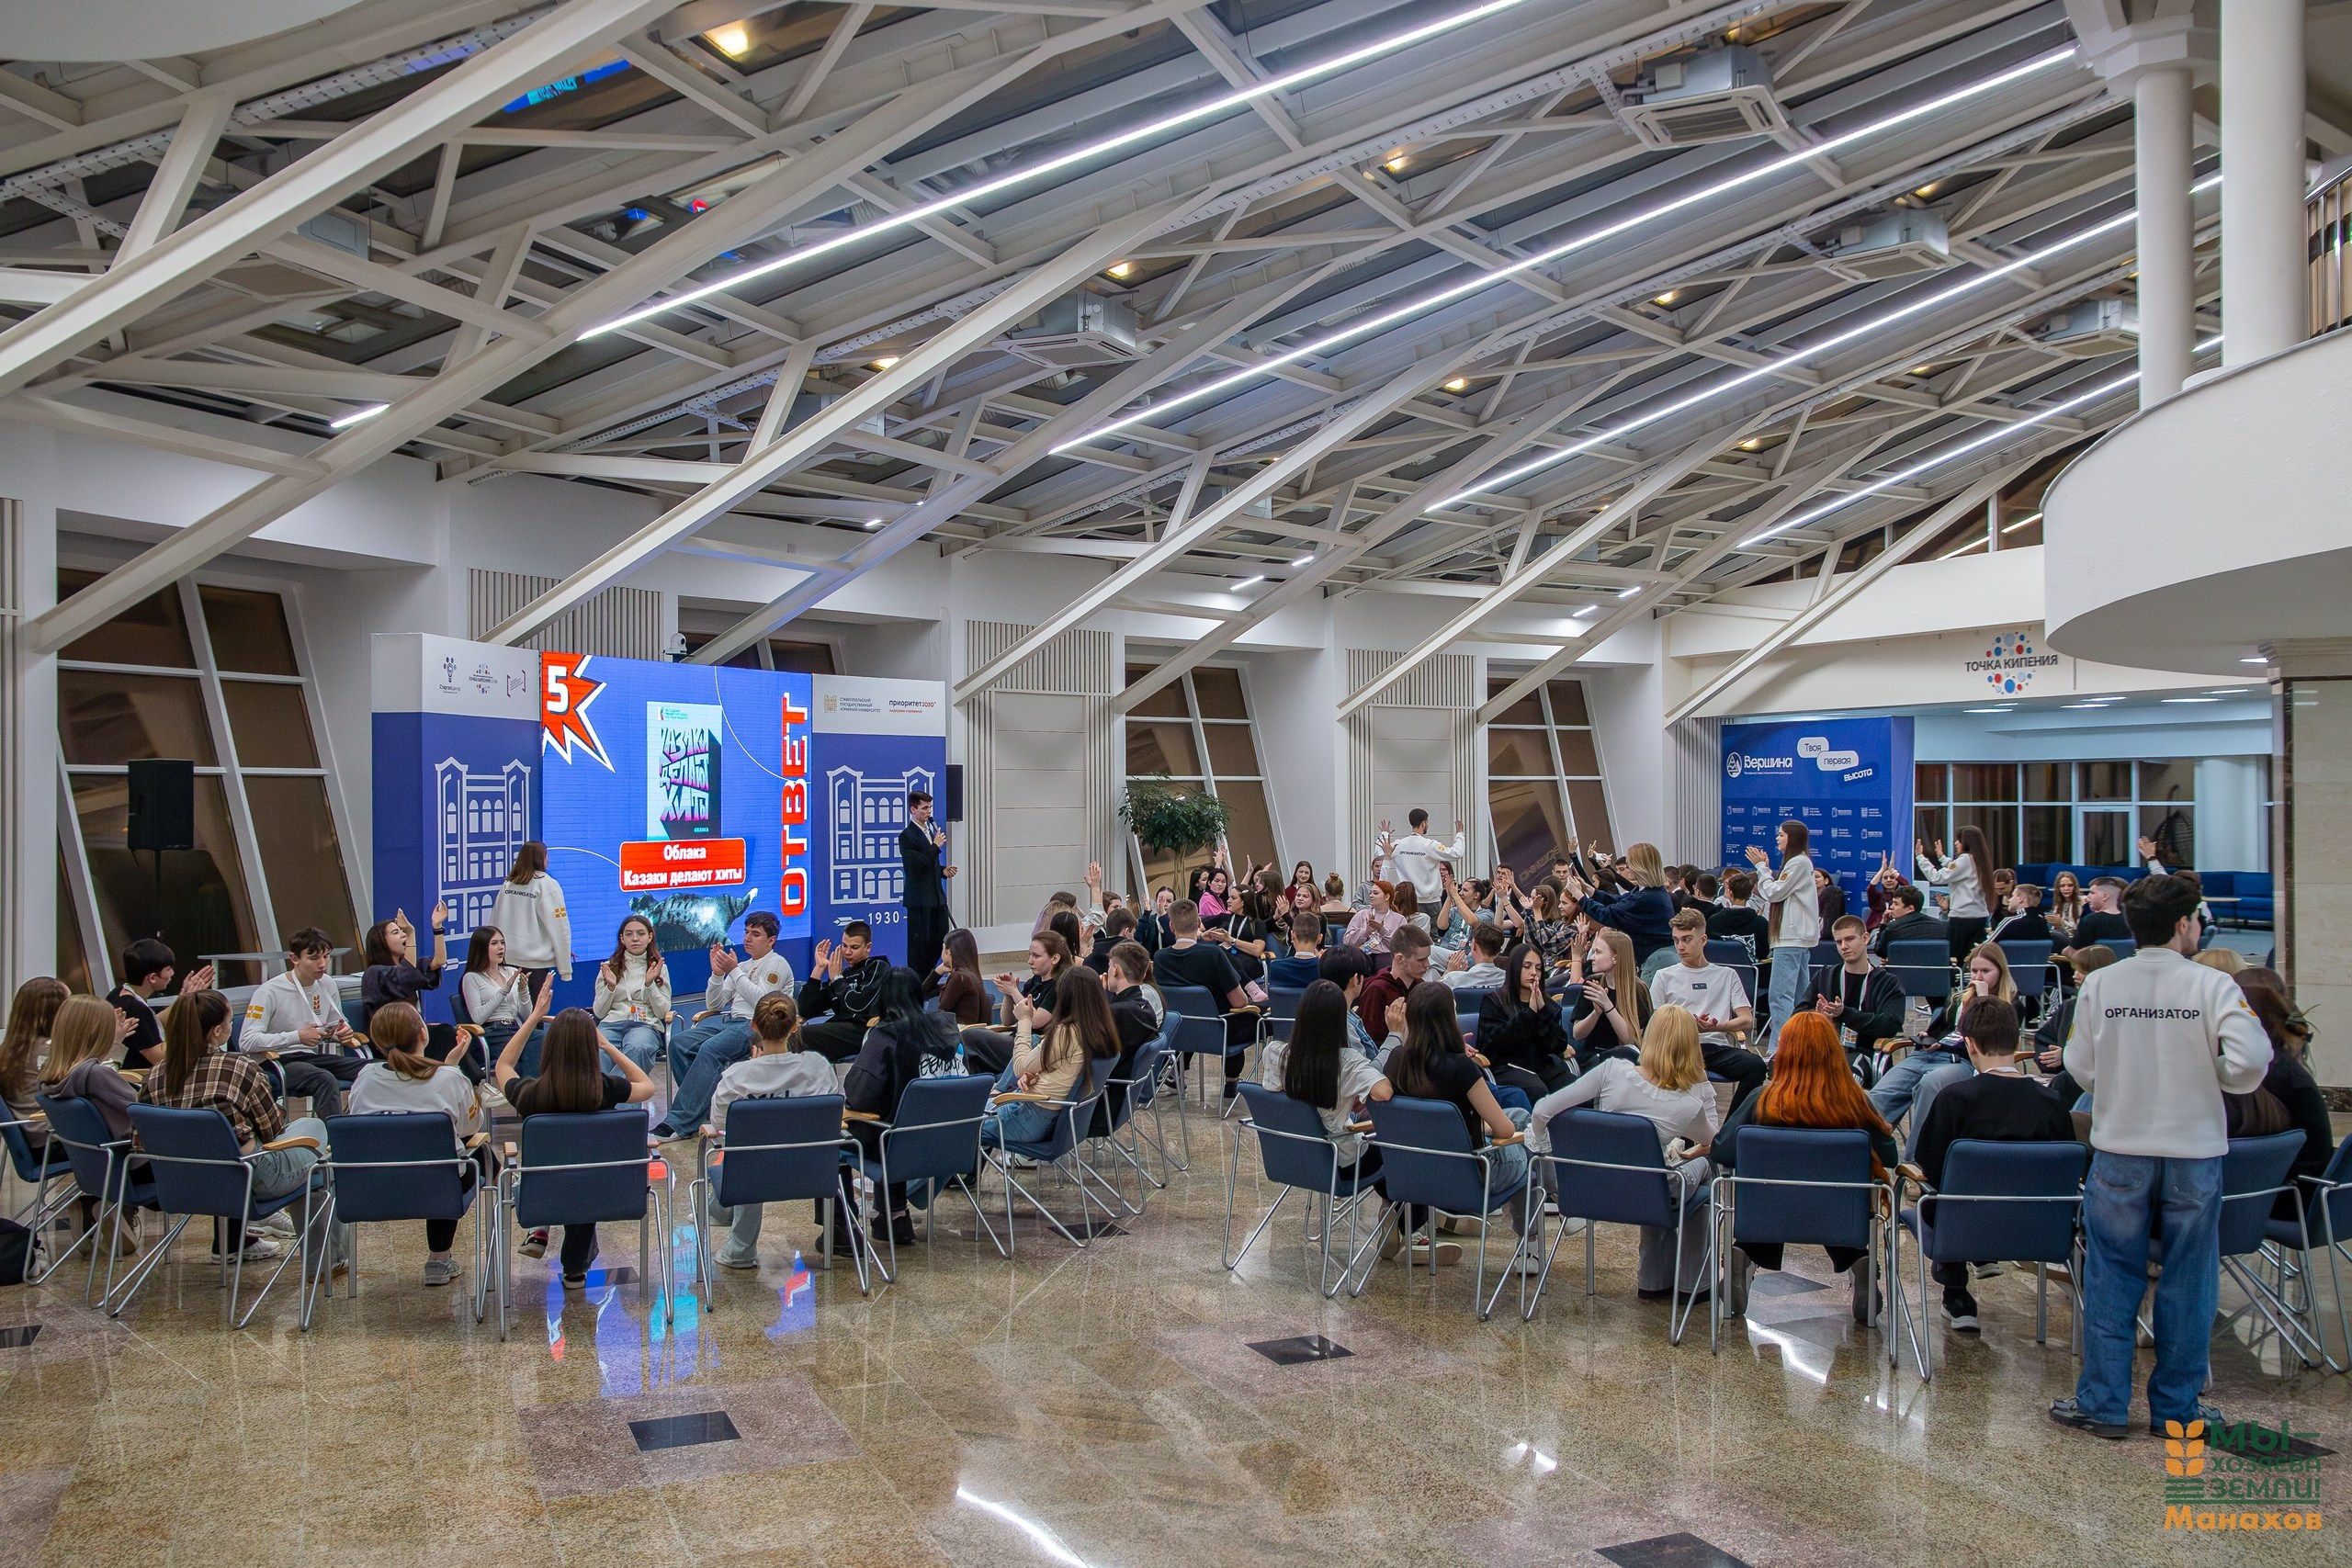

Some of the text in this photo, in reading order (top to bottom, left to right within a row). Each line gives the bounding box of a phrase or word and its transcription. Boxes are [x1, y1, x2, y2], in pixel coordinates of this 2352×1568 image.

[1964, 654, 2059, 671] ТОЧКА КИПЕНИЯ
[547, 665, 570, 715] 5
[1804, 742, 1822, 752] Твоя
[1744, 755, 1792, 771] Вершина
[1824, 756, 1851, 765] первая
[1844, 768, 1873, 782] высота
[660, 784, 709, 821] ХИТЫ
[781, 692, 808, 917] ОТВЕТ
[663, 844, 707, 861] Облака
[624, 868, 742, 886] Казаки делают хиты
[868, 910, 899, 925] 1930
[2105, 1008, 2200, 1020] ОРГАНИЗАТОР
